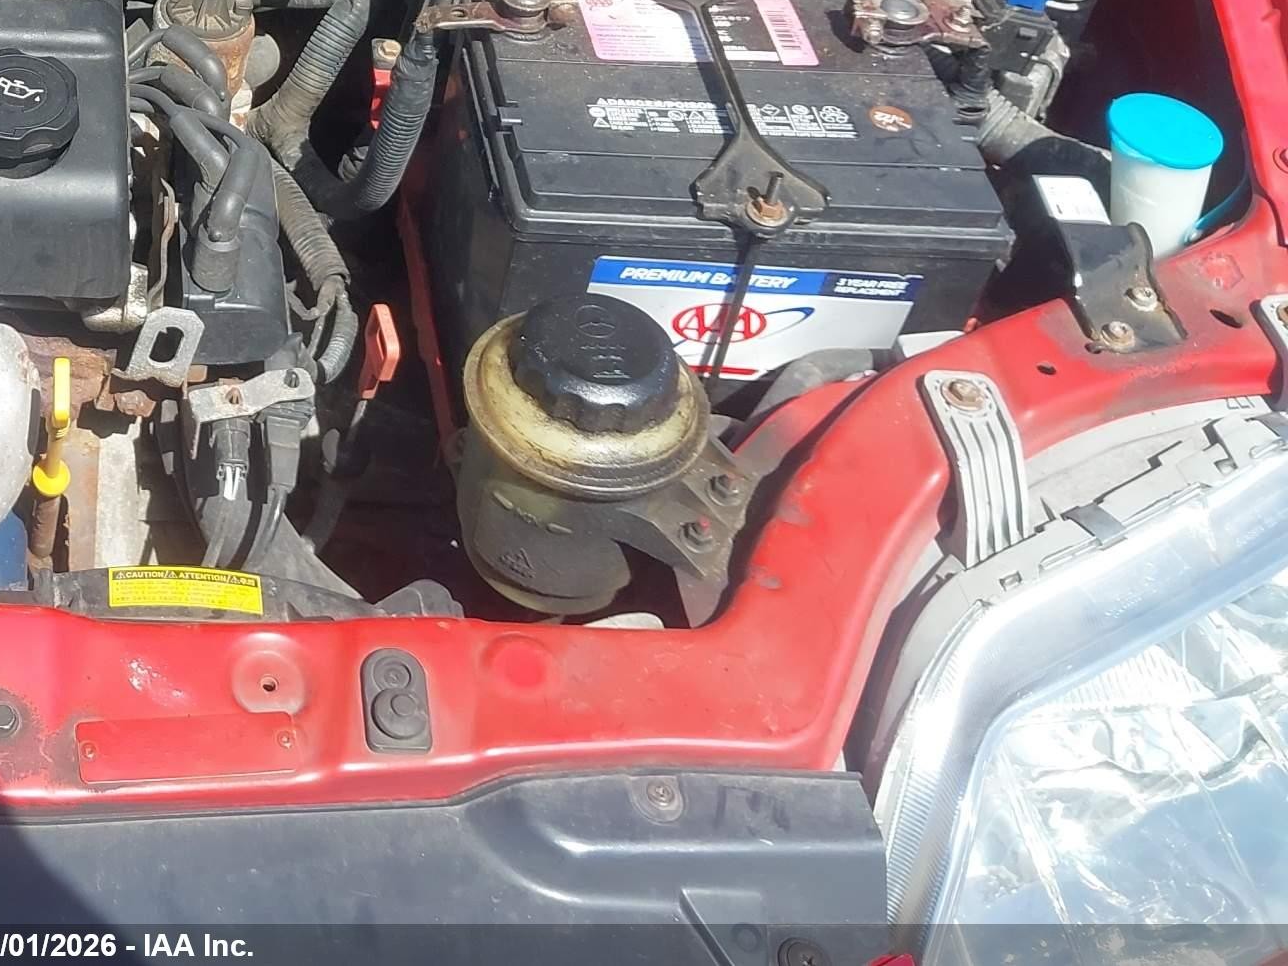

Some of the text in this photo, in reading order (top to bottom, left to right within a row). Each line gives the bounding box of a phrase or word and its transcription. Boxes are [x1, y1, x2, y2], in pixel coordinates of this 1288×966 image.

[619, 266, 799, 289] PREMIUM BATERY
[847, 278, 879, 288] YEAR
[877, 280, 910, 290] FREE
[833, 286, 906, 296] REPLACEMENT
[674, 304, 762, 343] AAA
